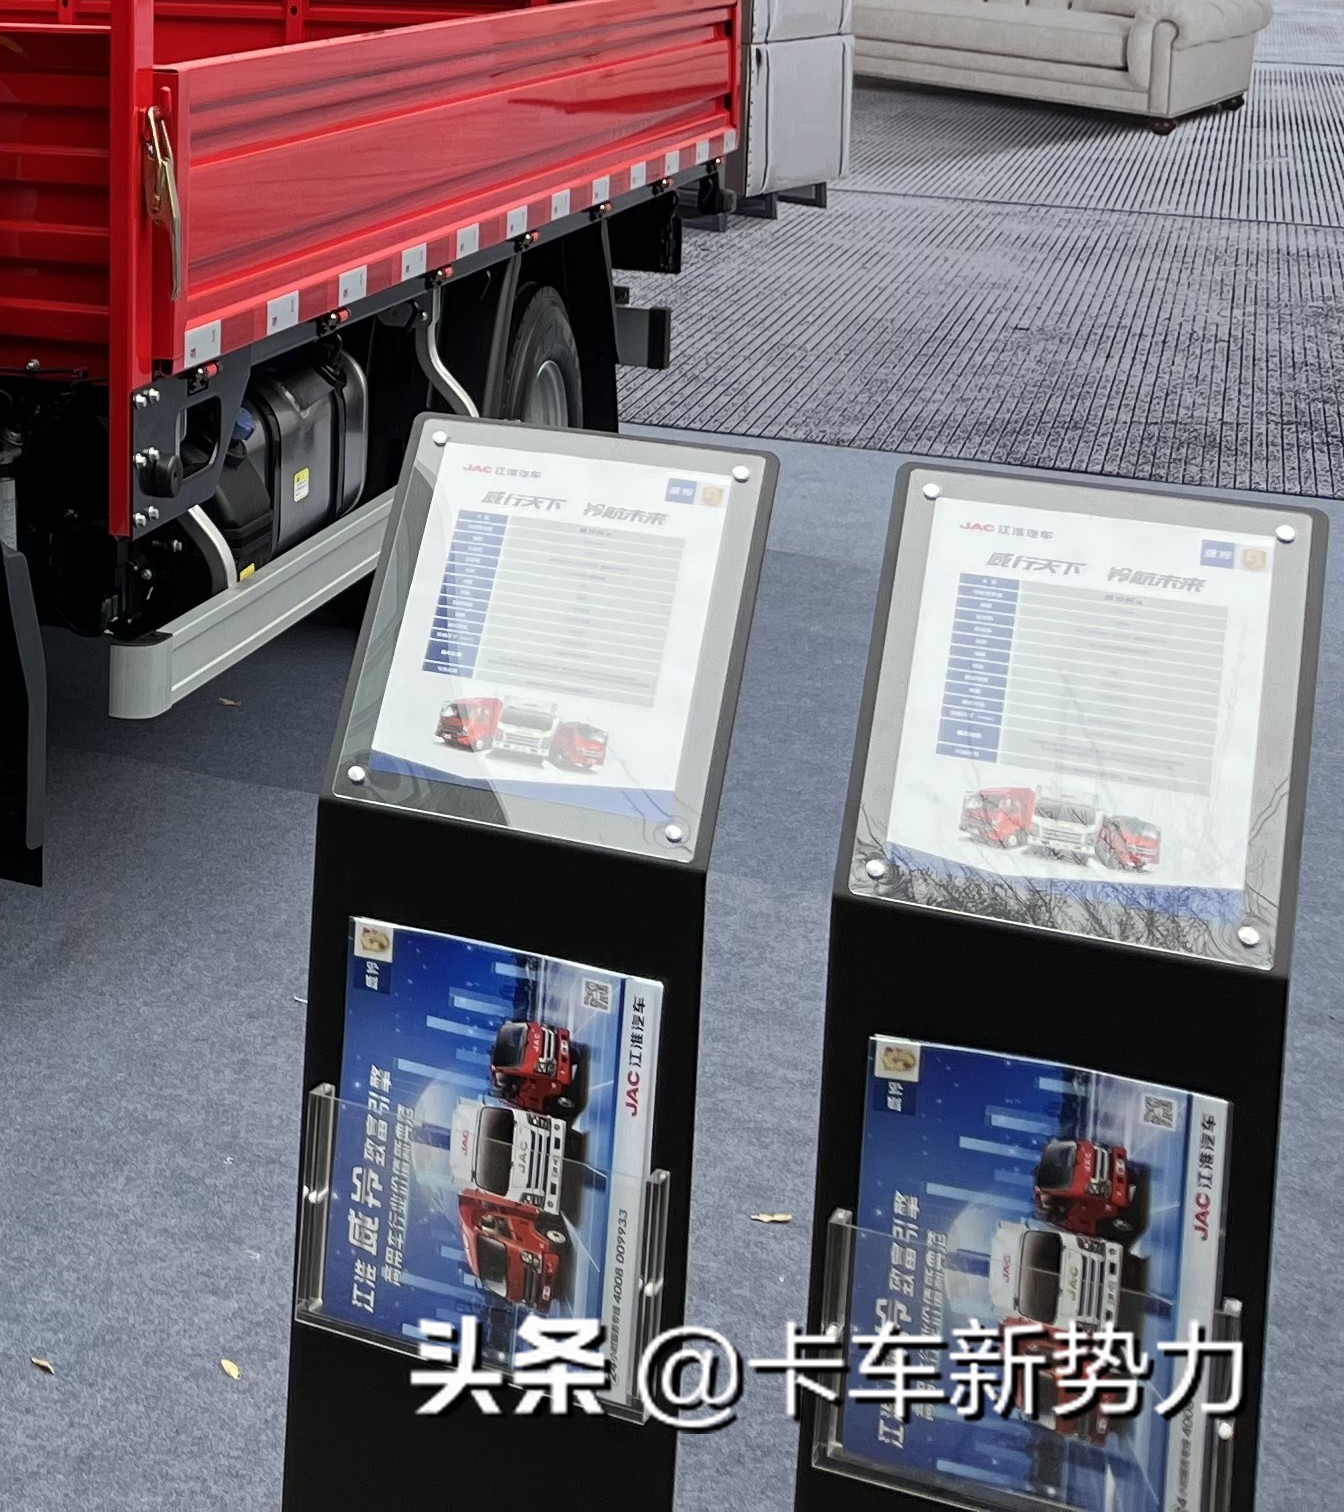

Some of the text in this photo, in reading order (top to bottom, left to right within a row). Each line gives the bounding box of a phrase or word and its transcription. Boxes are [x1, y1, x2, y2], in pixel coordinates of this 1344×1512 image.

[463, 463, 493, 474] JAC
[480, 490, 567, 511] 威行天下
[960, 521, 994, 533] JAC
[985, 552, 1087, 576] 威行天下
[625, 995, 647, 1118] JAC 江淮汽车
[1193, 1113, 1218, 1241] JAC 江淮汽车
[614, 1209, 629, 1264] 009933
[612, 1267, 625, 1304] 4008
